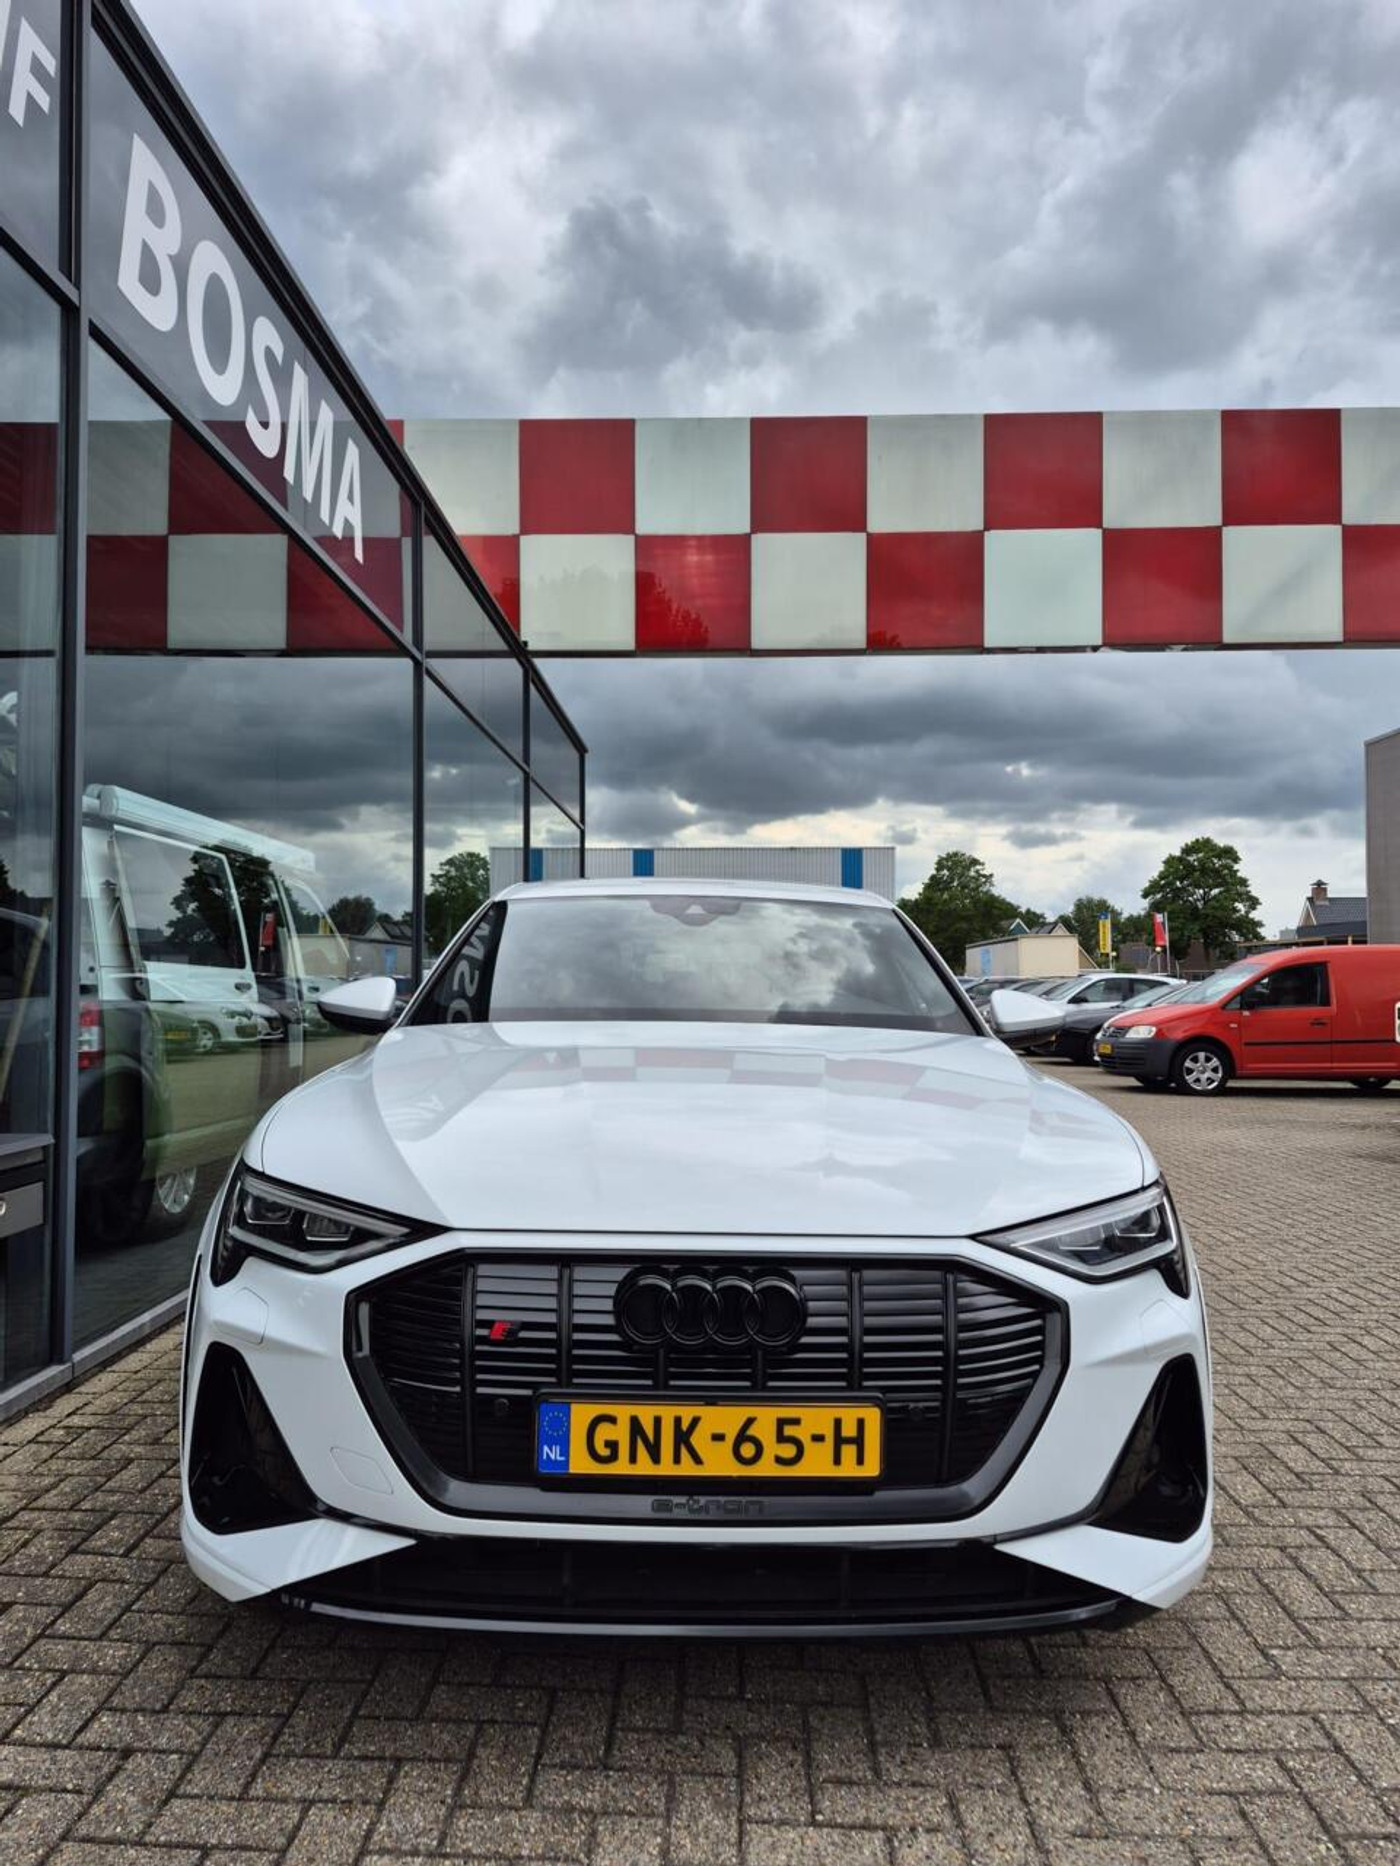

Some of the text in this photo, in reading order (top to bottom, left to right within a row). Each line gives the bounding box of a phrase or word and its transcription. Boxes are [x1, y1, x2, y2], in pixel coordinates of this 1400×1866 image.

[117, 132, 364, 564] BOSMA
[543, 1445, 566, 1461] NL
[586, 1413, 866, 1467] GNK-65-H
